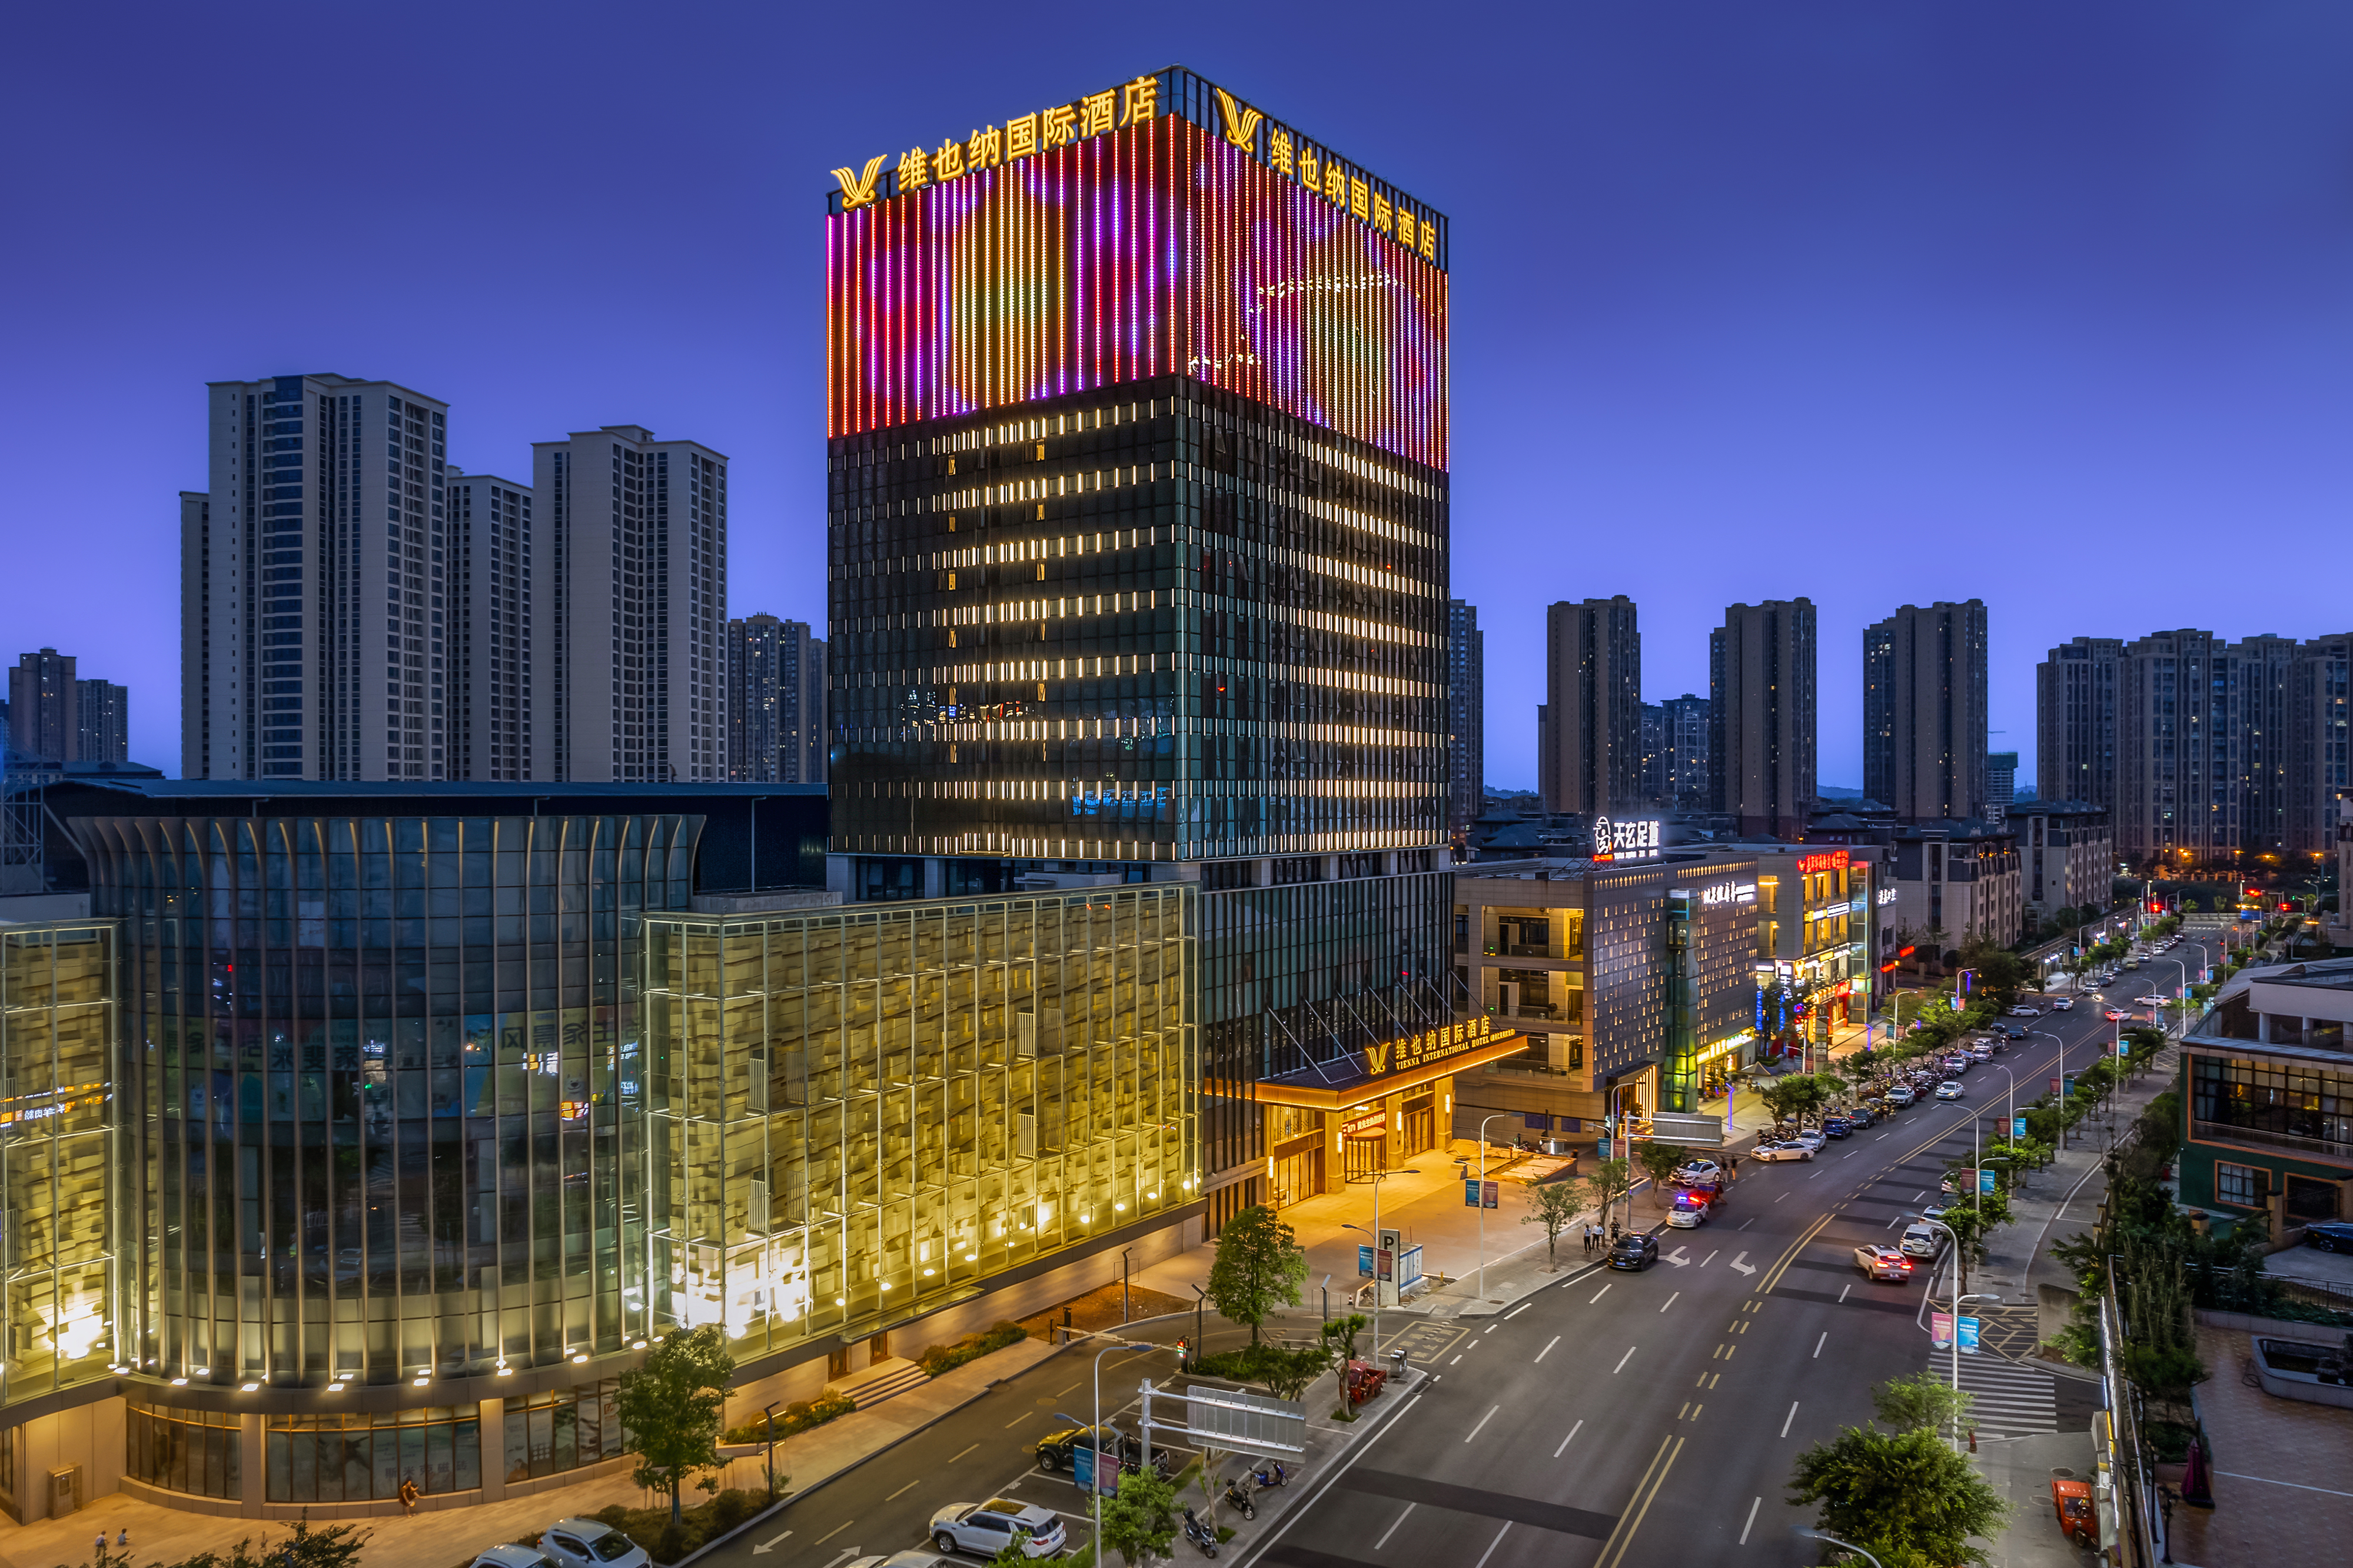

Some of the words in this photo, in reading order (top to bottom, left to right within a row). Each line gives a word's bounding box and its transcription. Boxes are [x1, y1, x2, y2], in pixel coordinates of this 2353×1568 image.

[898, 76, 1158, 191] 维也纳国际酒店
[1271, 128, 1435, 261] 维也纳国际酒店
[1396, 1015, 1490, 1059] 维也纳国际酒店
[1396, 1057, 1420, 1070] VIENNA
[1423, 1041, 1469, 1063] INTERNATIONAL
[1472, 1036, 1489, 1047] HOTEL
[1384, 1236, 1394, 1250] P
